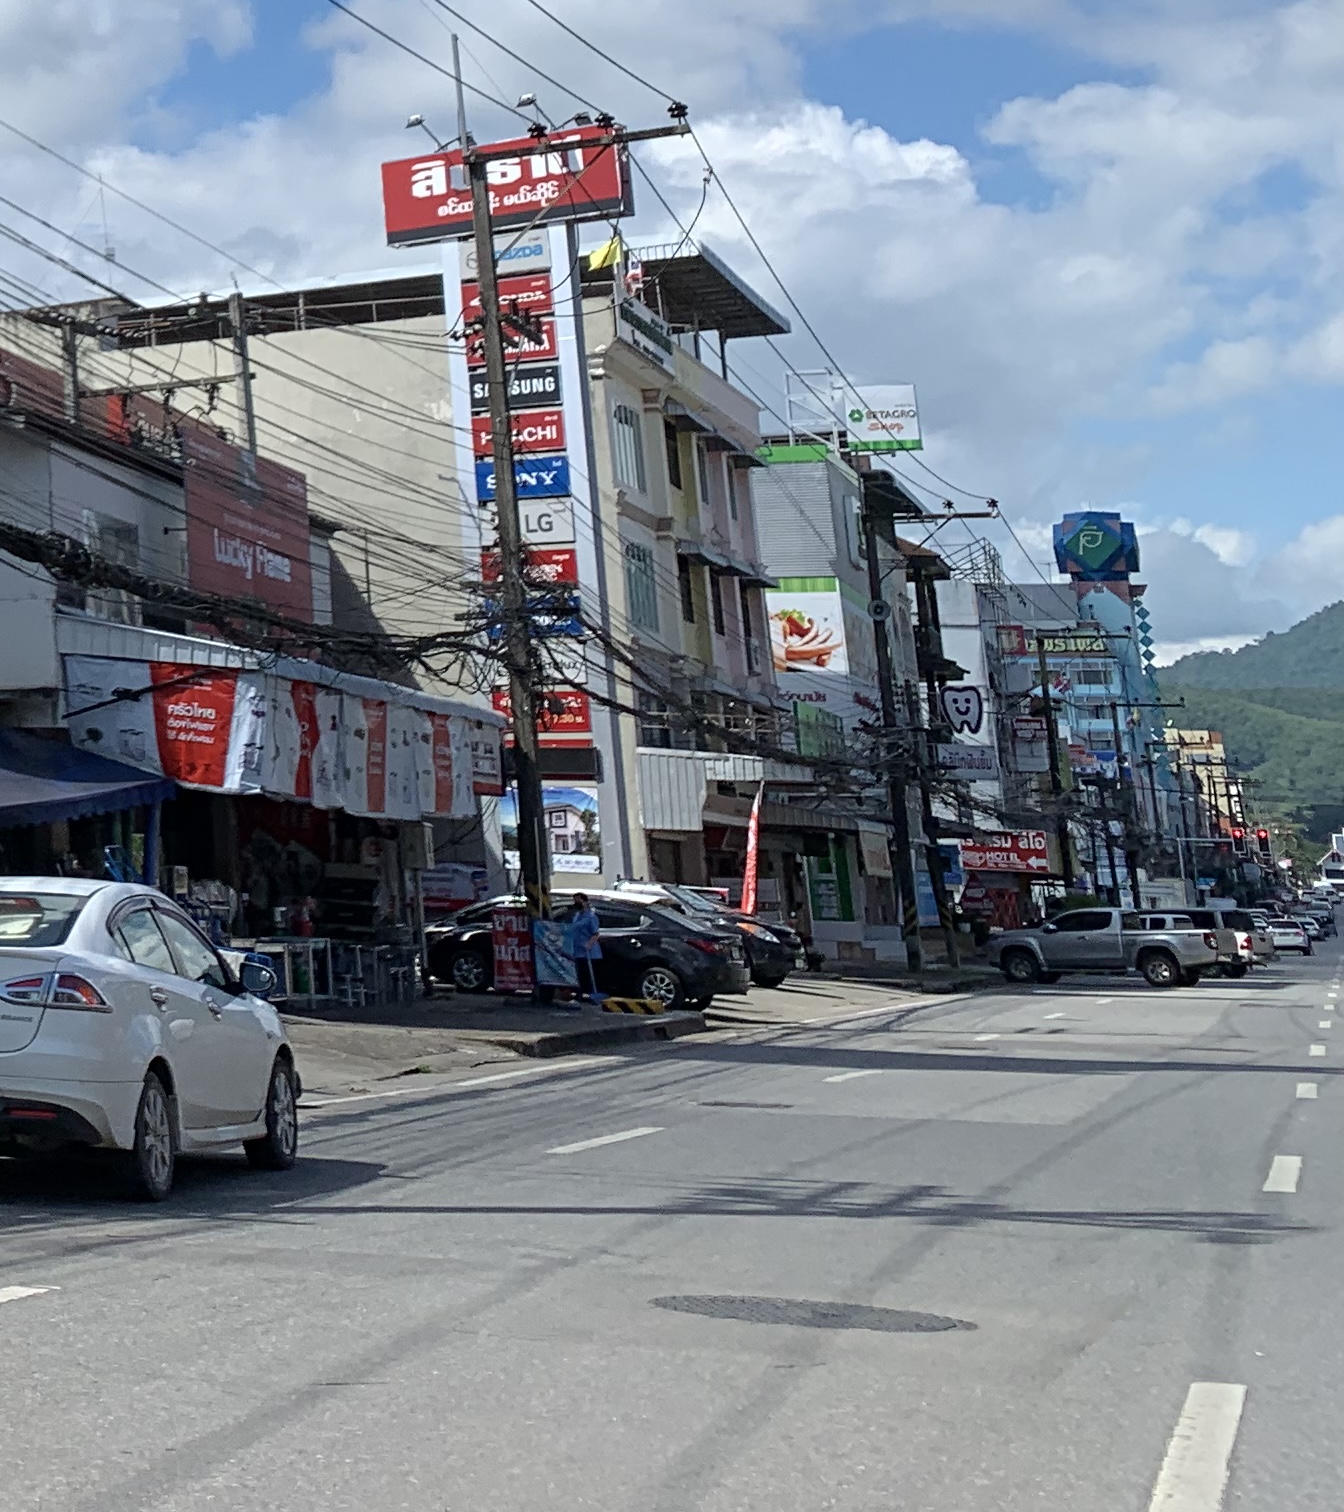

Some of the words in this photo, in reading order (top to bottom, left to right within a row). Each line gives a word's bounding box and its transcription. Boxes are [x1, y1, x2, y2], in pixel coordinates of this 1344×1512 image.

[473, 376, 555, 399] SASUNG
[480, 424, 557, 447] HACHI
[486, 470, 559, 491] SNY
[525, 512, 554, 534] LG
